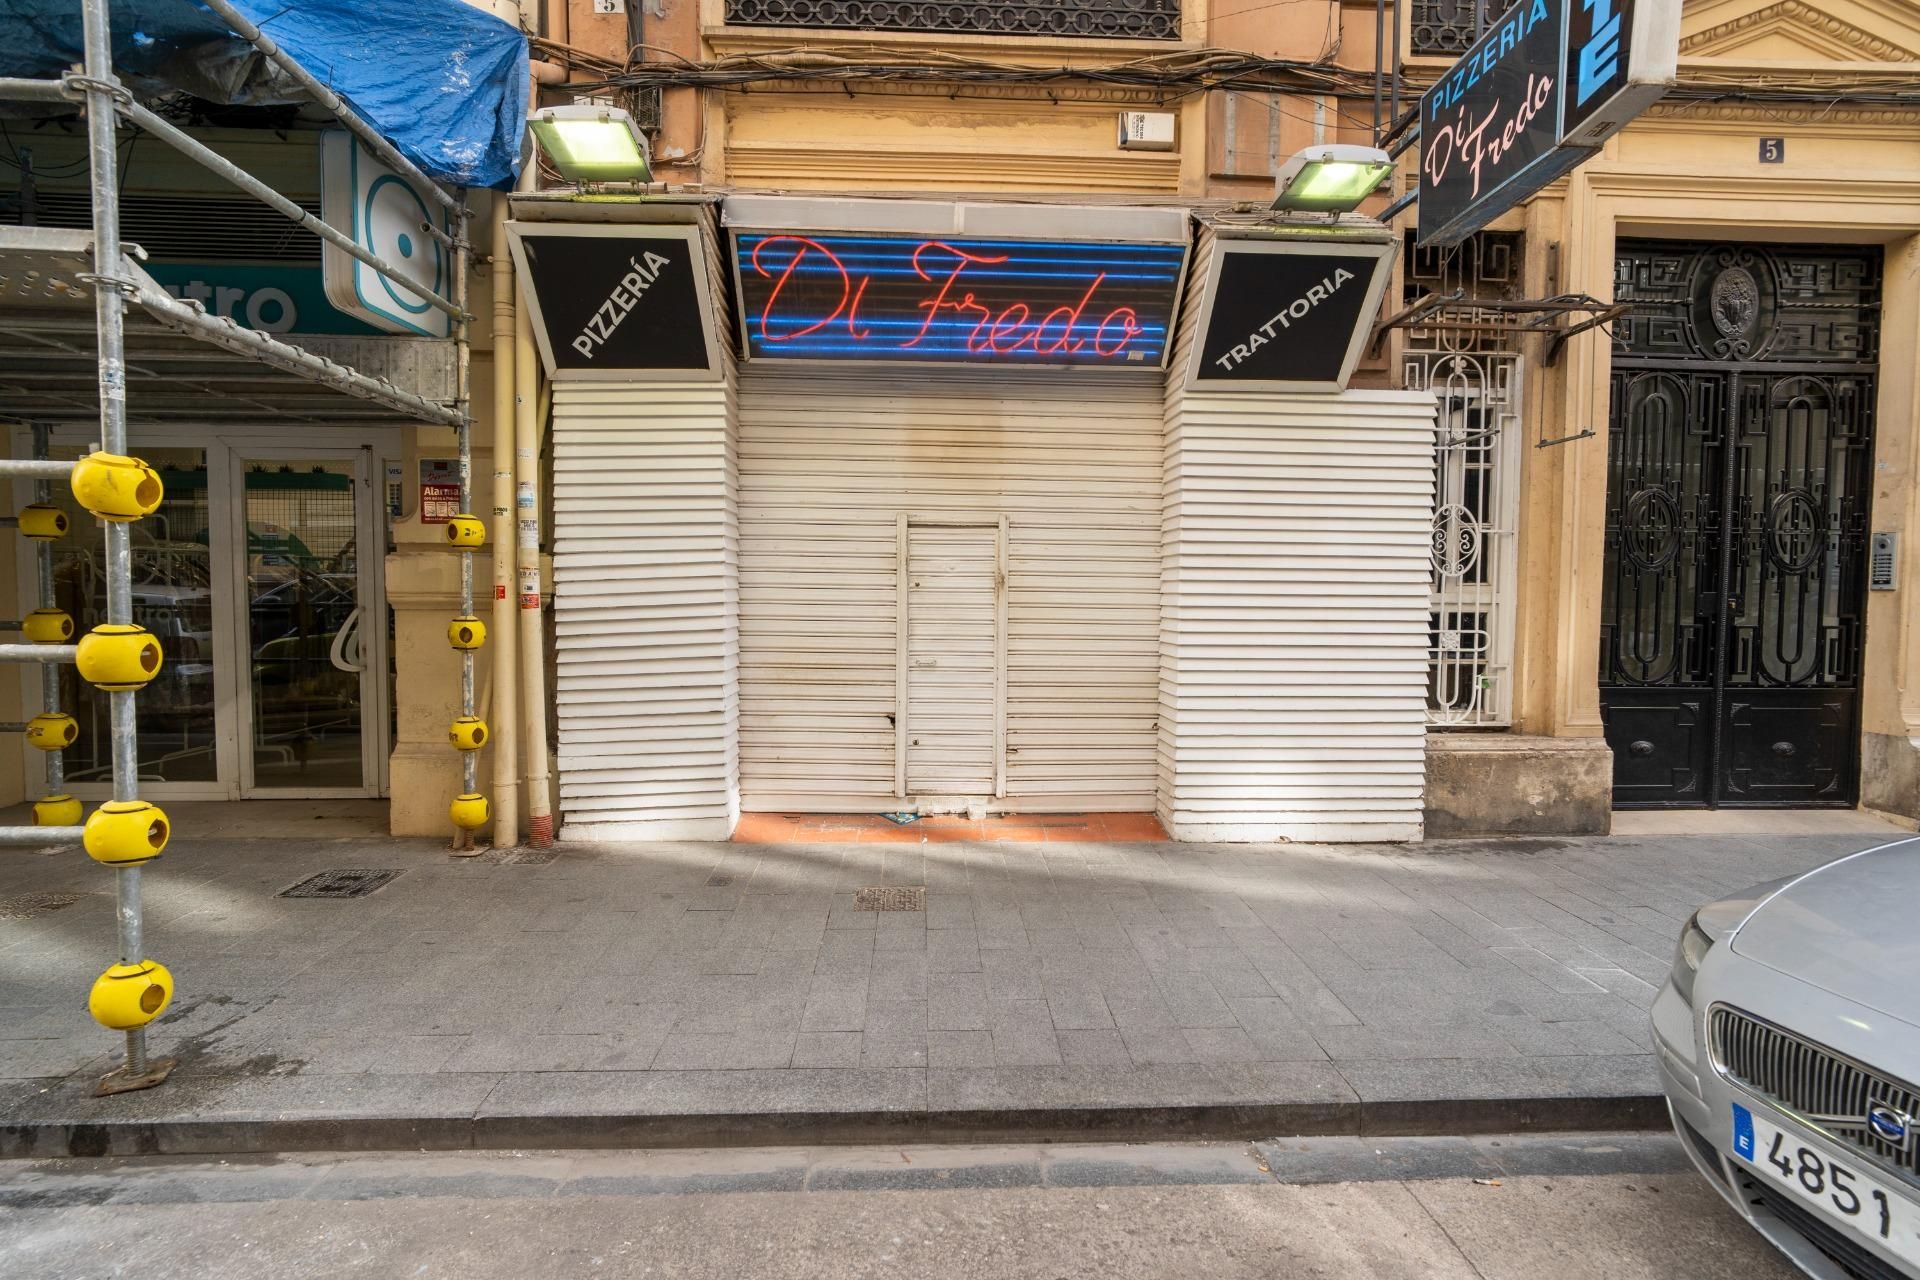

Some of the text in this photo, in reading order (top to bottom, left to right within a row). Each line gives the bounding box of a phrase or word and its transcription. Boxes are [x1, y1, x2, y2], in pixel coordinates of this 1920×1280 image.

[1431, 0, 1549, 122] PIZZERIA
[1461, 73, 1553, 200] Fredo
[1766, 140, 1777, 160] 5
[571, 251, 671, 359] PIZZERÍA
[752, 235, 1143, 356] Di Fredo
[1215, 268, 1355, 371] TRATTORIA
[423, 486, 459, 496] Alarma
[1738, 1135, 1750, 1150] E
[1768, 1131, 1891, 1239] 4851
